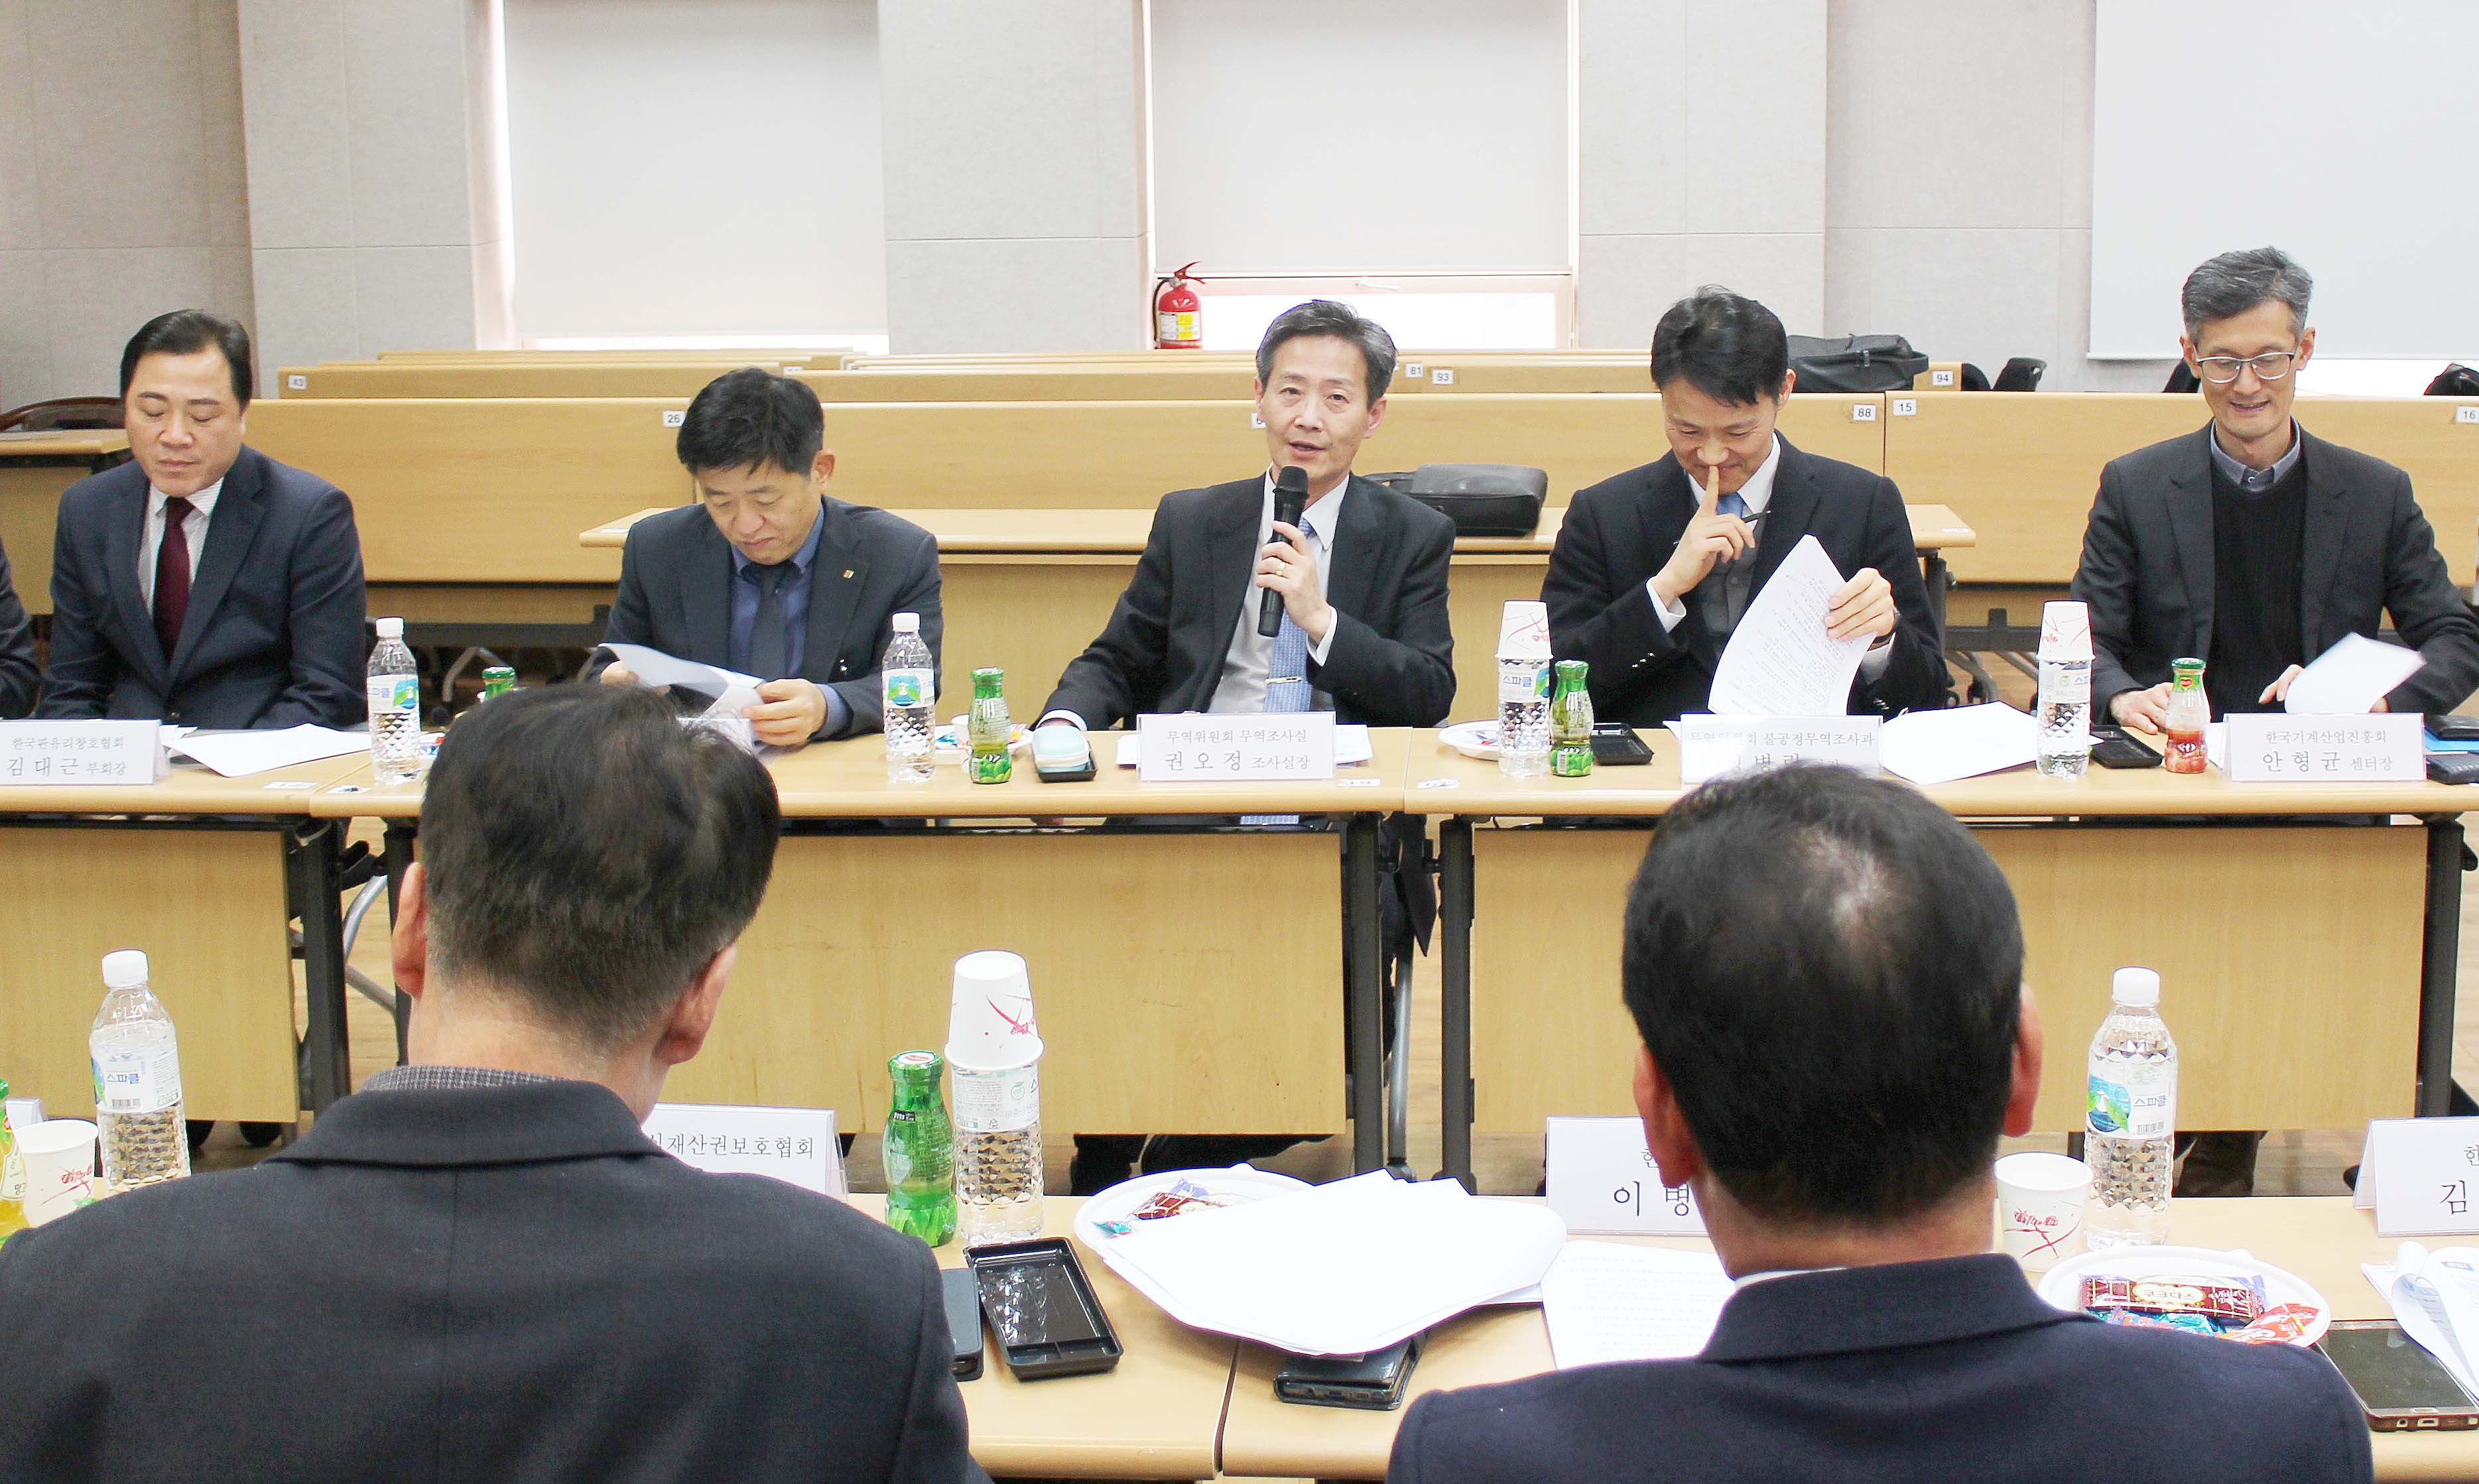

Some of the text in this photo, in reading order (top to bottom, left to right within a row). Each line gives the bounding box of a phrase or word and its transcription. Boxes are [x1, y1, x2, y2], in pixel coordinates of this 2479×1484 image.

[1437, 373, 1449, 381] 93
[1858, 408, 1871, 417] 88
[1899, 403, 1912, 412] 15
[667, 414, 680, 423] 26
[2463, 410, 2476, 420] 16
[1167, 729, 1308, 743] 무역위원회 무역조사실
[1764, 732, 1874, 746] 불공정무역조사과
[2265, 730, 2387, 744] 한국기계산업진흥회
[87, 761, 127, 776] 부회장
[1251, 755, 1310, 770] 조사실장
[2351, 756, 2393, 771] 센터장
[107, 1073, 139, 1084] 스파클
[2133, 1095, 2166, 1107] 스파클
[2440, 1180, 2468, 1215] 김
